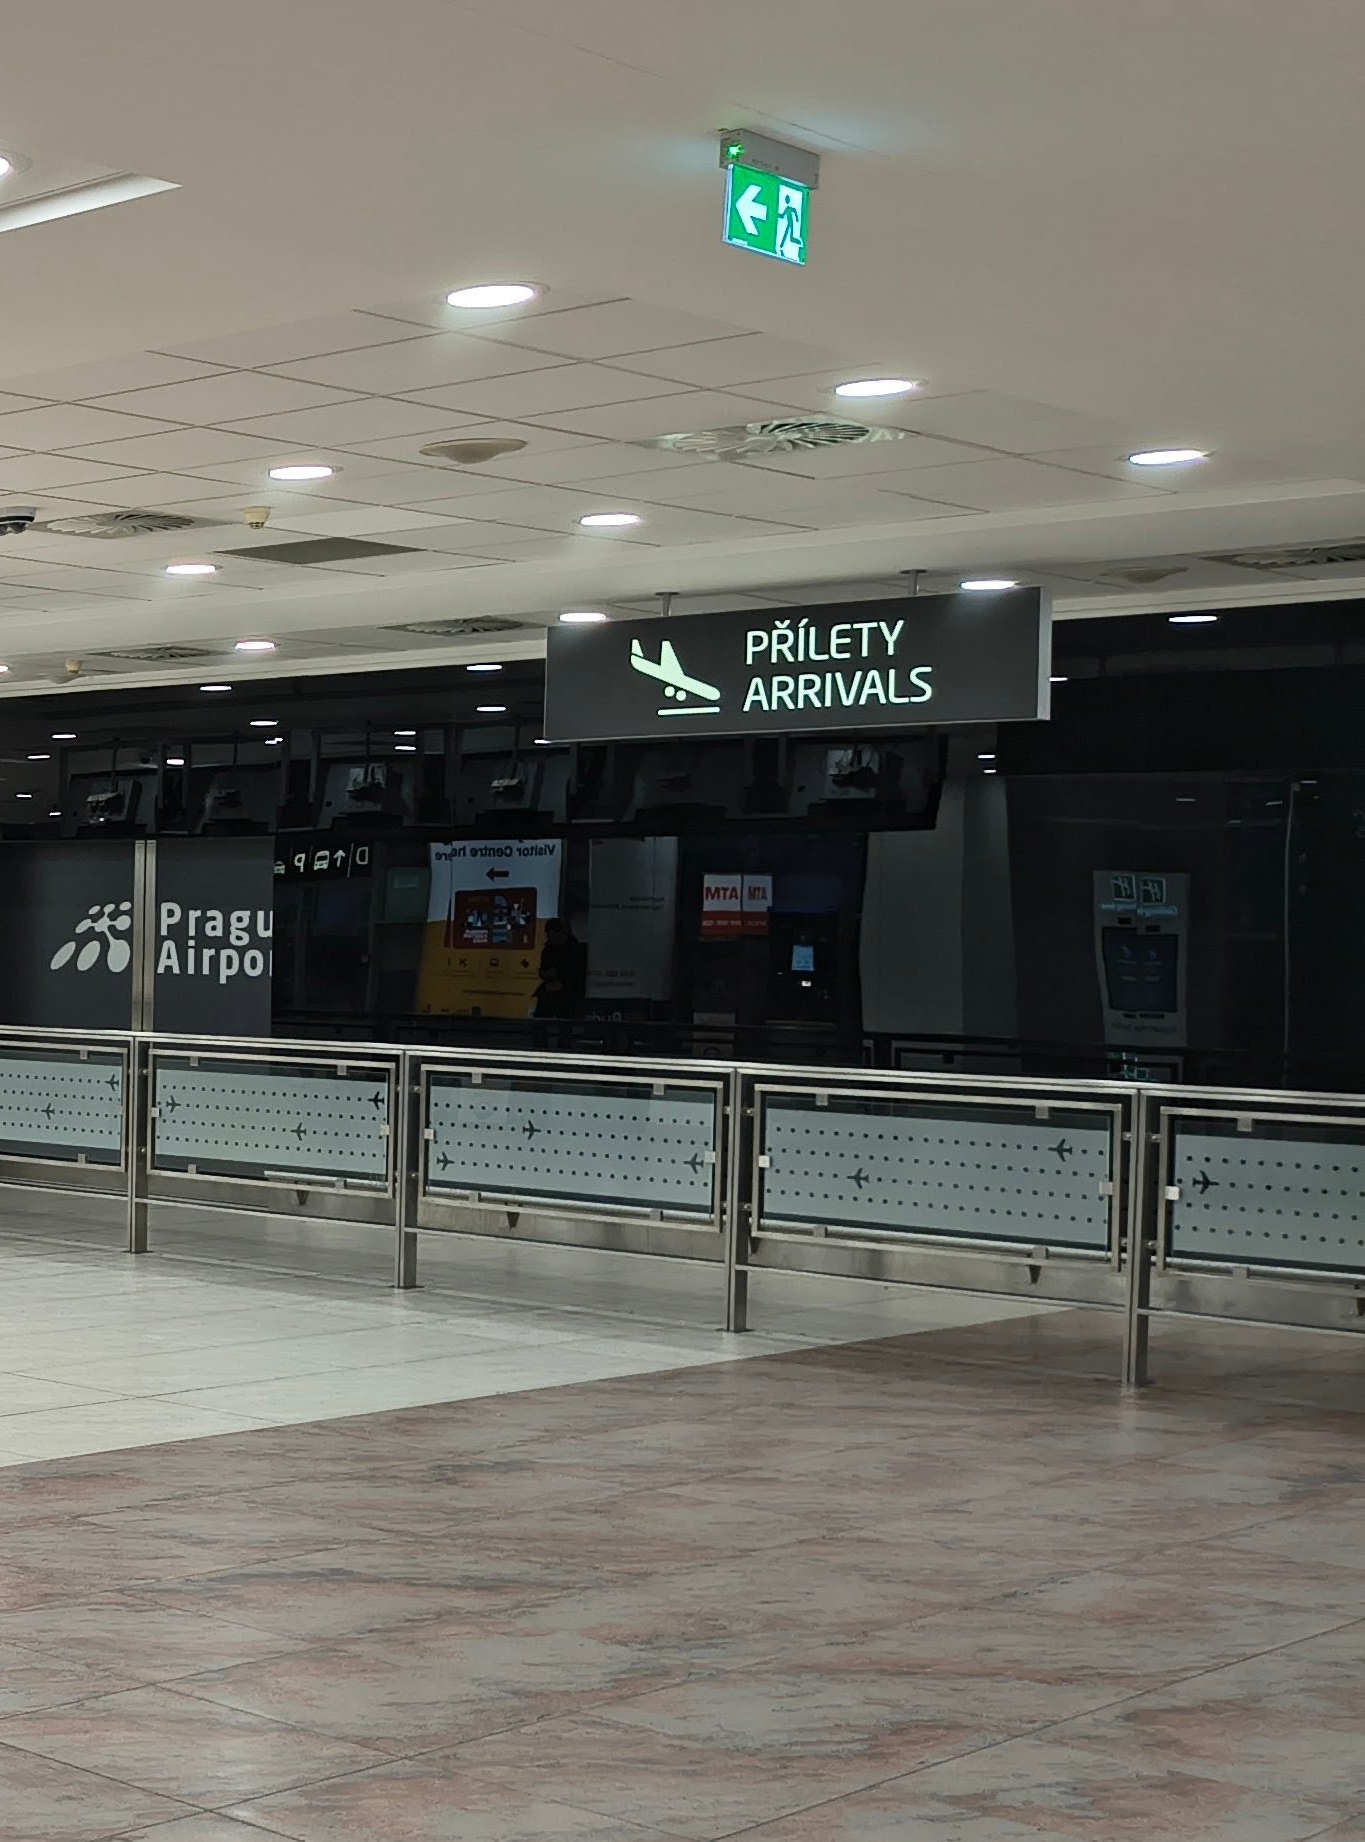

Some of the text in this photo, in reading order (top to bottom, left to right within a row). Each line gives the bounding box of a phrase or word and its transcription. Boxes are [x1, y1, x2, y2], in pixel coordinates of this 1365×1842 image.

[745, 618, 905, 665] PŘÍLETY
[742, 666, 933, 712] ARRIVALS
[160, 901, 273, 946] Pragu
[157, 939, 272, 984] Airpo
